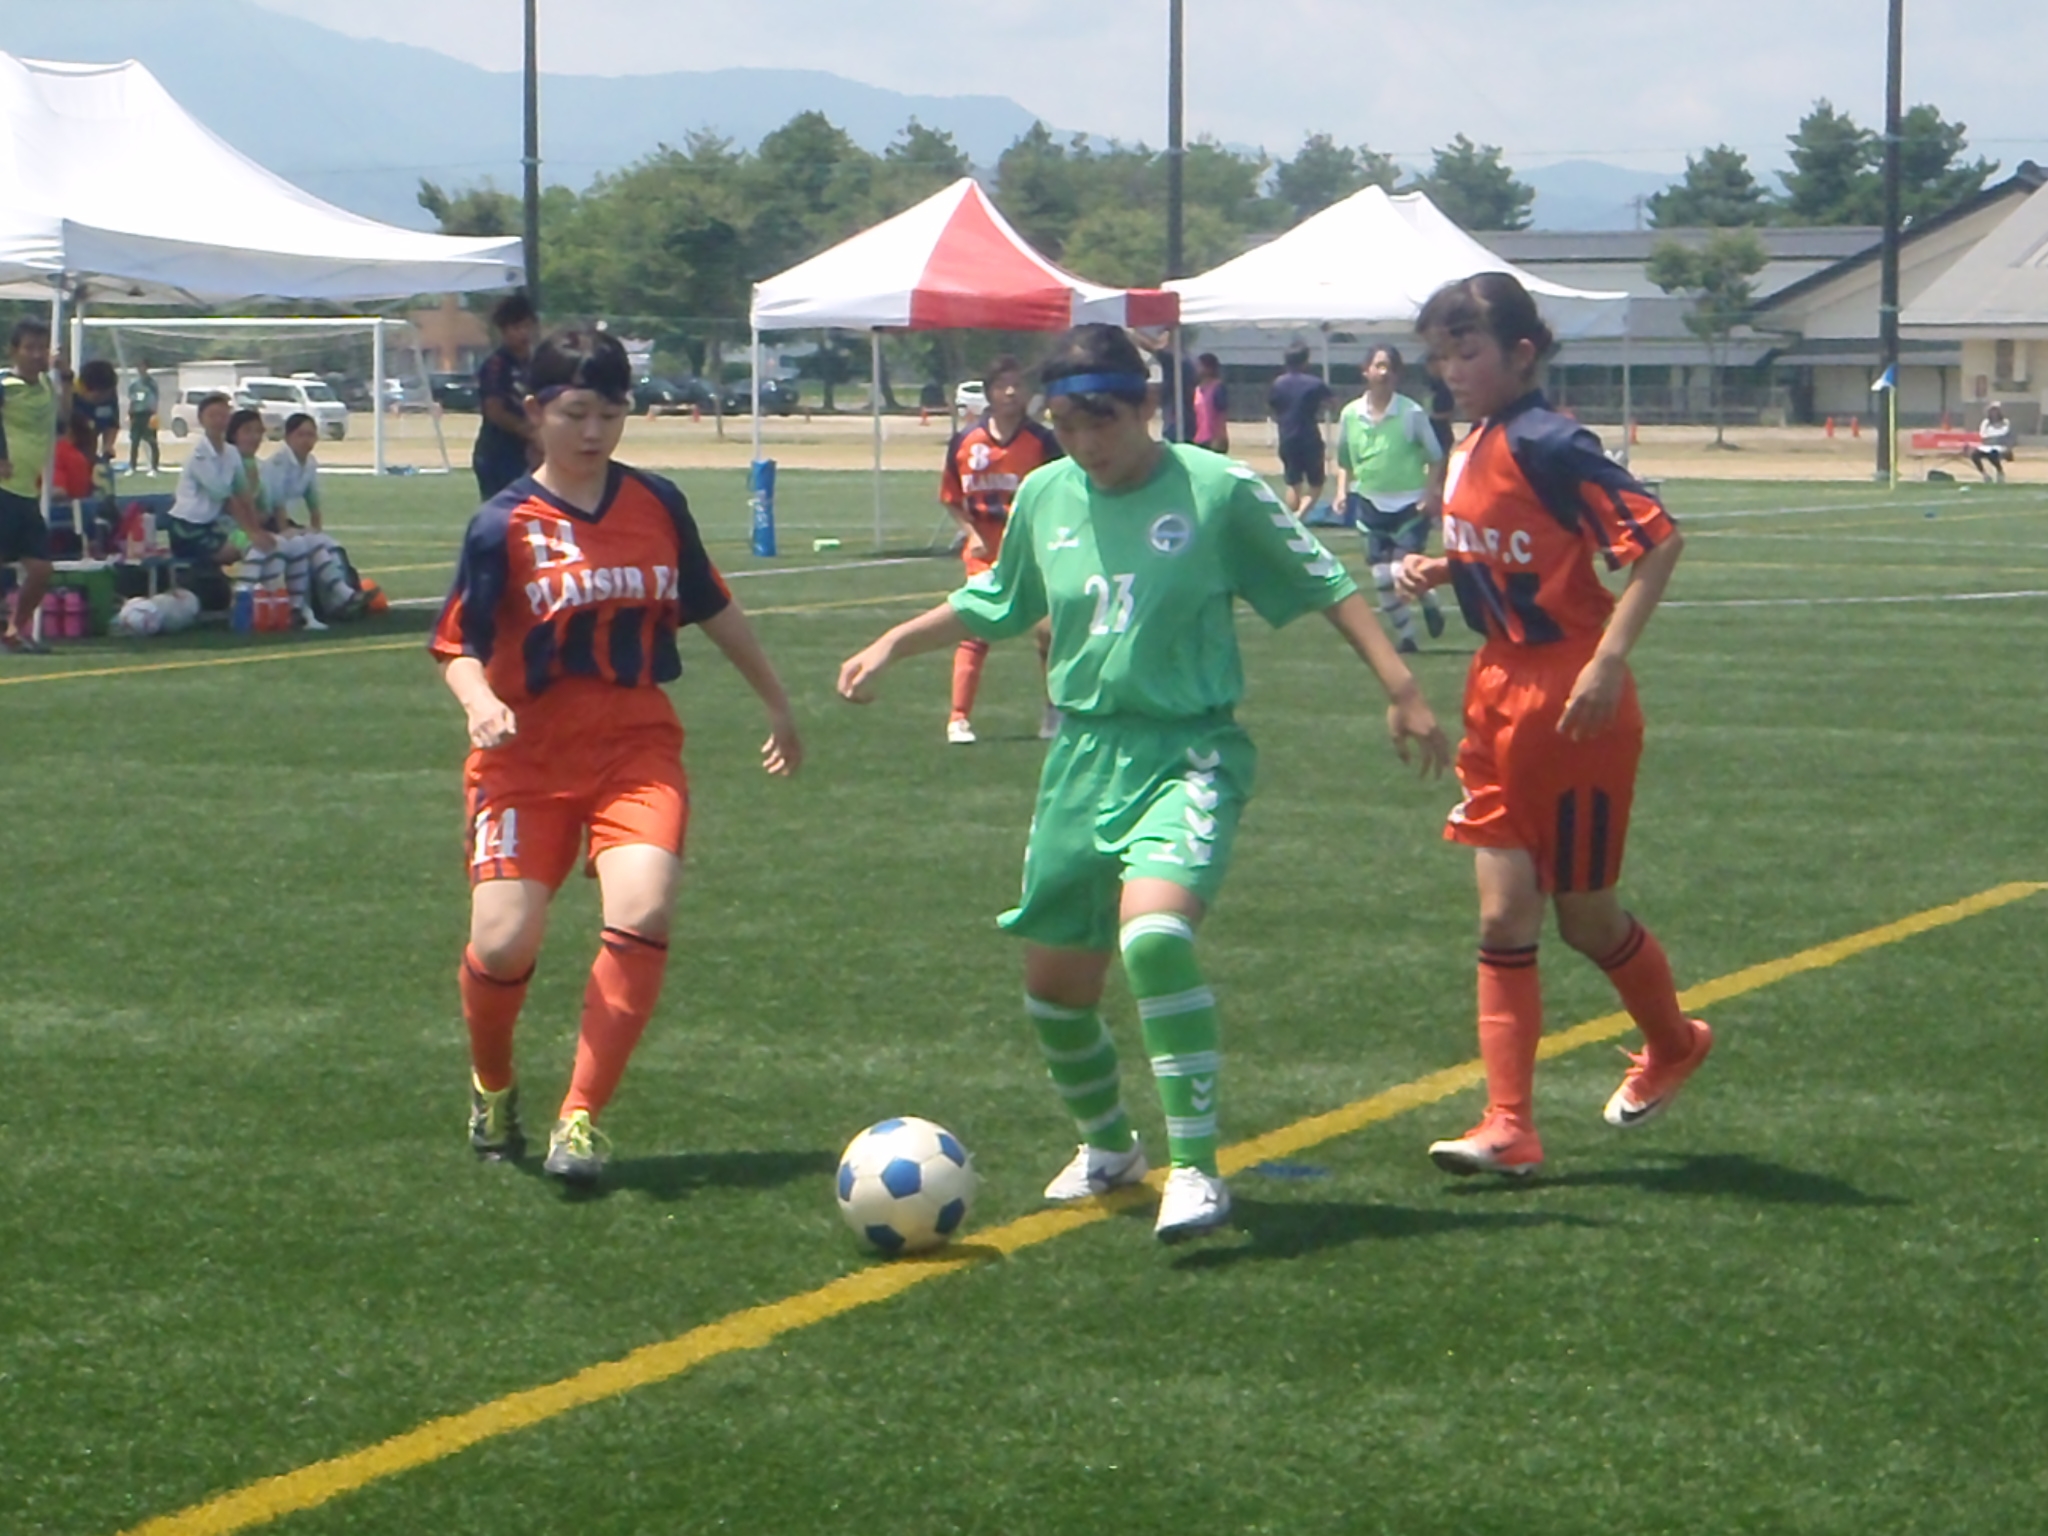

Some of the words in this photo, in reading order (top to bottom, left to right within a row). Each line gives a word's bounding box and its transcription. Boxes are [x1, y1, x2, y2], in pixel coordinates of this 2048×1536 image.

[967, 443, 990, 470] 8
[525, 566, 645, 616] PLAISIR
[1085, 572, 1135, 635] 23
[473, 808, 518, 866] 14
